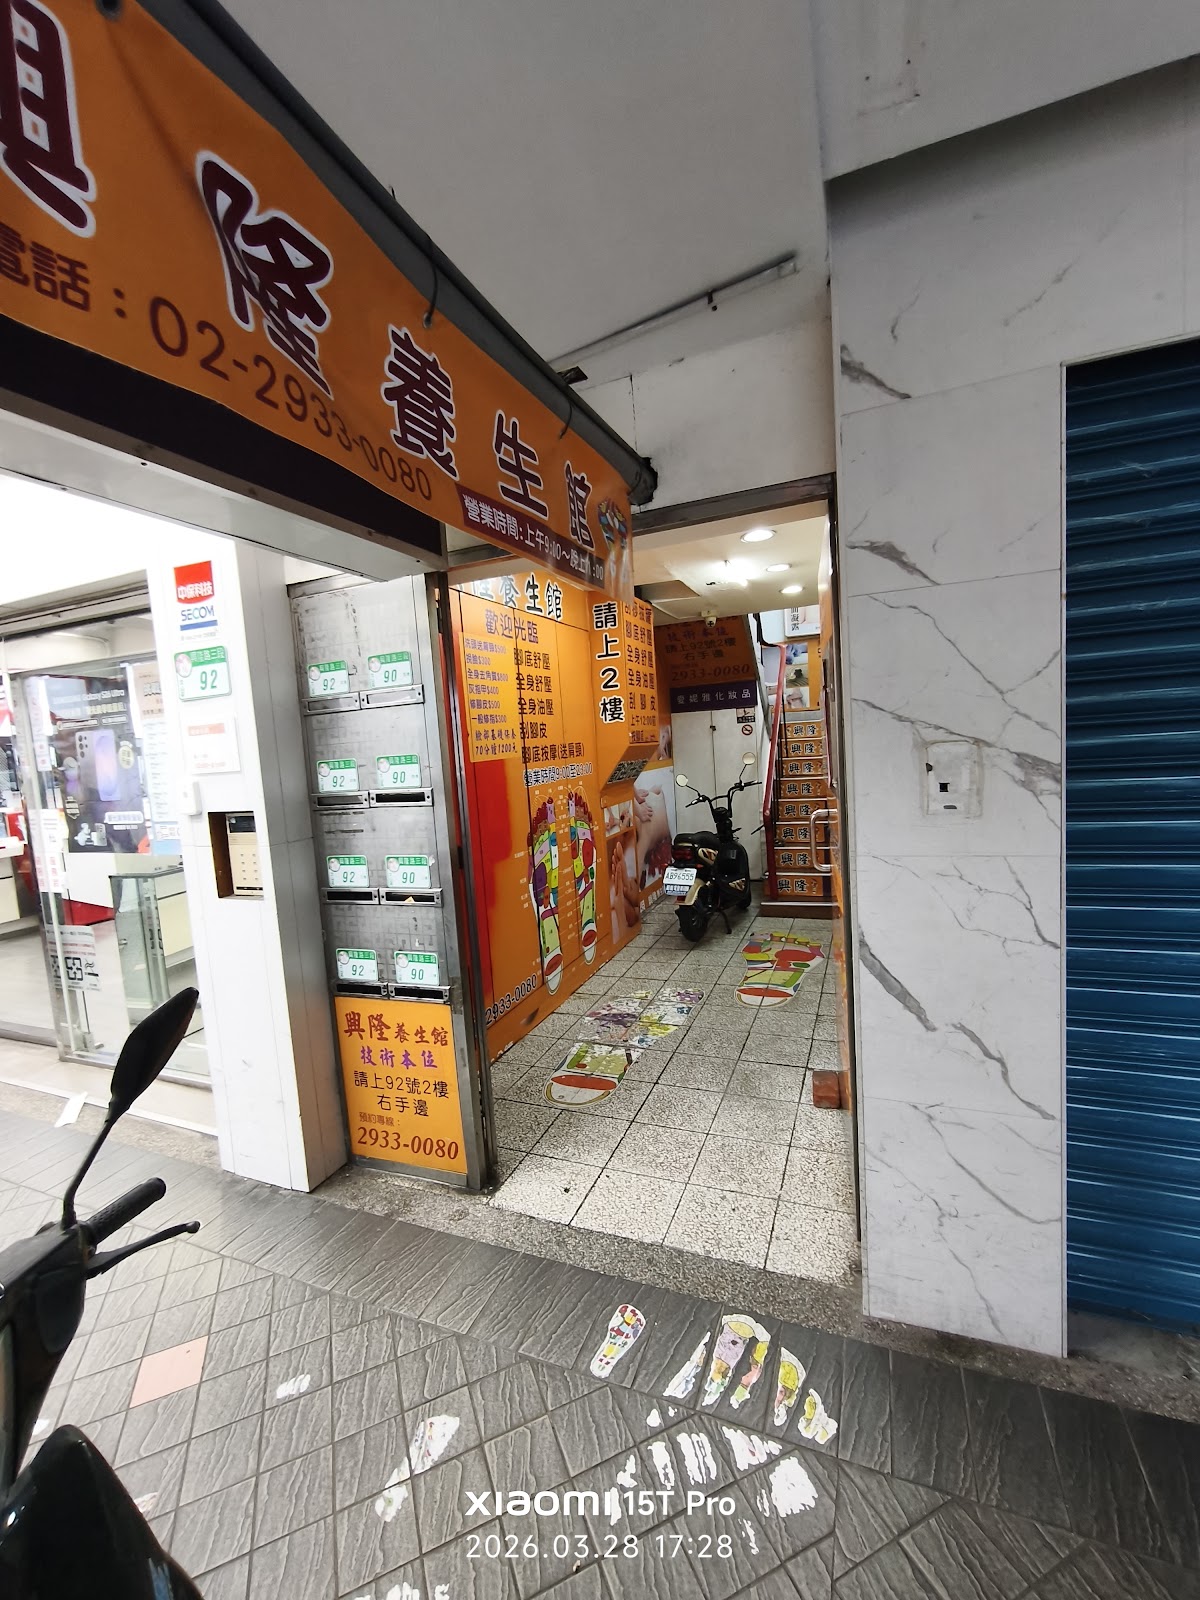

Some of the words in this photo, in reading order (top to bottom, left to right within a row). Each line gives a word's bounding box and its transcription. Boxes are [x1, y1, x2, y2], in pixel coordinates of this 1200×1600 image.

[177, 581, 213, 600] 中保科技
[180, 604, 215, 622] SECOM
[485, 608, 539, 644] 歡迎光臨
[593, 600, 625, 724] 請上2樓
[200, 669, 217, 690] 92
[322, 677, 336, 691] 92
[383, 669, 397, 683] 90
[515, 672, 552, 693] 全身舒壓
[332, 775, 345, 788] 92
[392, 771, 406, 784] 90
[342, 871, 356, 883] 92
[401, 871, 416, 884] 90
[351, 964, 365, 977] 92
[411, 968, 425, 981] 90
[485, 973, 538, 1026] 2933-0080
[343, 1010, 449, 1047] 興隆養生館
[360, 1045, 438, 1070] 技術本位
[353, 1070, 449, 1099] 請上92號2樓
[376, 1094, 429, 1117] 右手邊
[357, 1126, 459, 1160] 2933-0080
